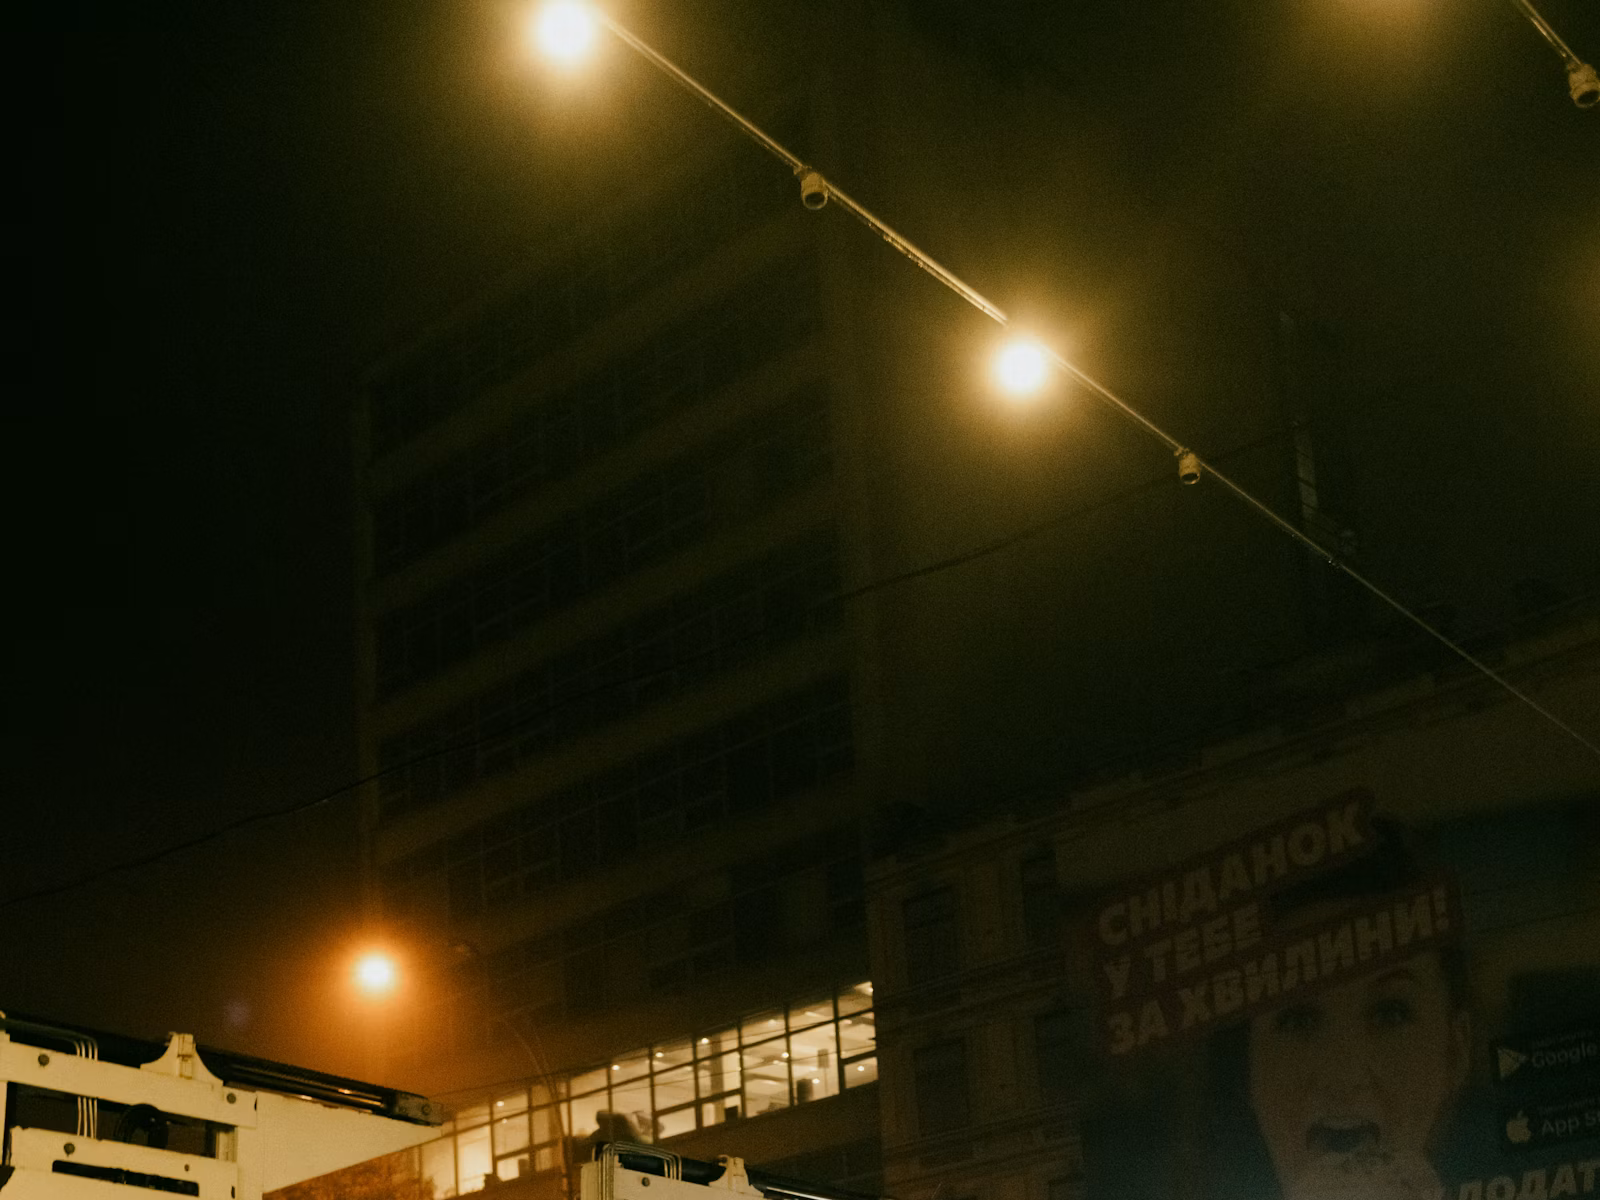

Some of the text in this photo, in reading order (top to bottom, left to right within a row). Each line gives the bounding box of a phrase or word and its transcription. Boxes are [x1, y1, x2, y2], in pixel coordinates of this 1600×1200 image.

[1099, 801, 1365, 945] СНІДАНОК
[1103, 902, 1261, 1000] У ТЕБЕ
[1108, 885, 1449, 1054] ЗА ХВИЛИНИ!
[1531, 1041, 1598, 1068] Google
[1541, 1114, 1581, 1137] App
